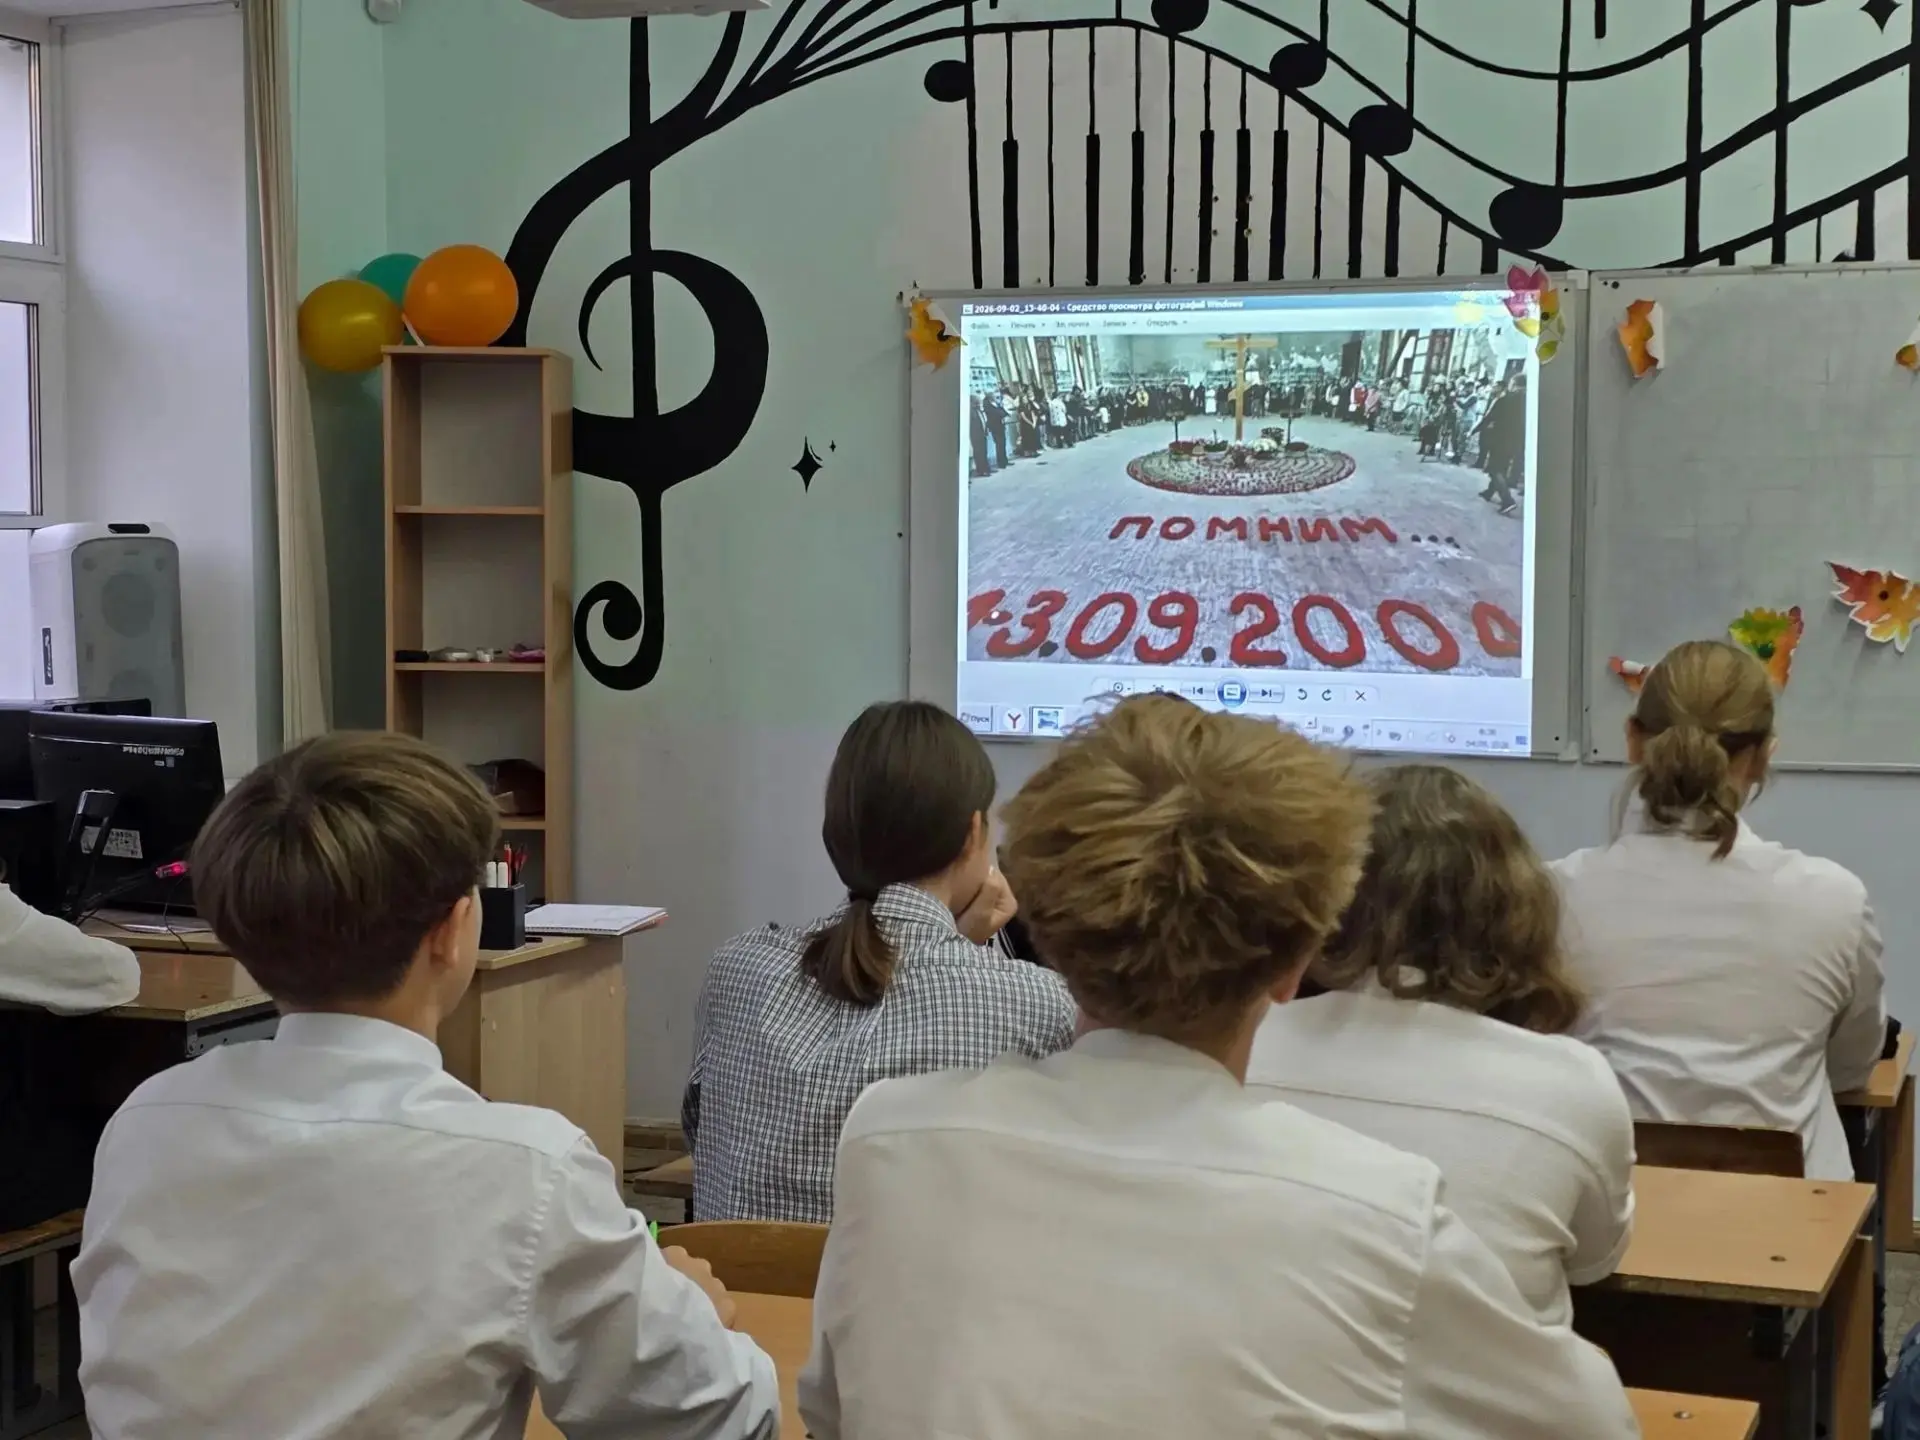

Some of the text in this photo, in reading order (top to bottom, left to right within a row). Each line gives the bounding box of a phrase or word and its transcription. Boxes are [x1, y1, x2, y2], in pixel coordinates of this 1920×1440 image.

[1066, 302, 1107, 313] Средство
[1108, 302, 1153, 313] просмотра
[1154, 300, 1205, 312] фотографий
